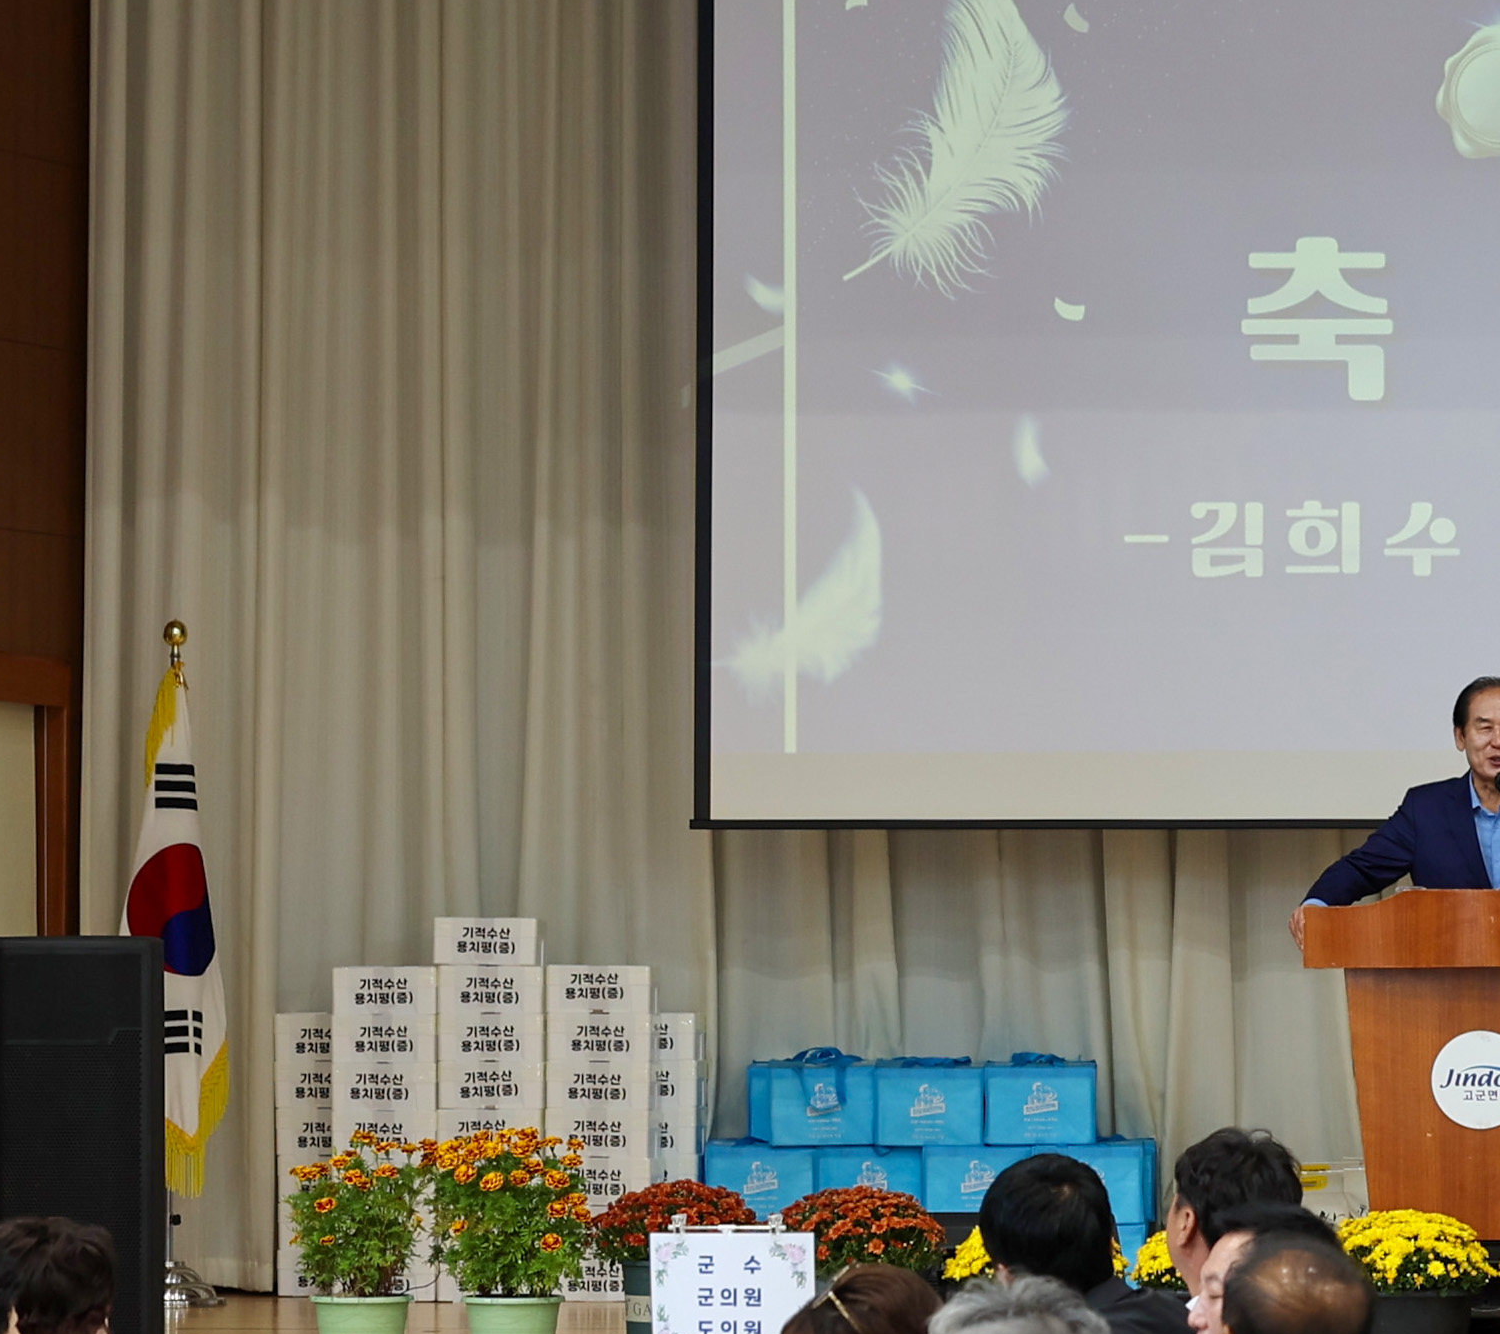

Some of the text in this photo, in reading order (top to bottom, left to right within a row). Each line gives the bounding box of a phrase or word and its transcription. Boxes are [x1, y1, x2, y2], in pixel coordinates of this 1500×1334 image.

[1240, 235, 1396, 403] 축
[1124, 499, 1464, 580] -김희수
[462, 927, 510, 939] 기적수산
[359, 978, 408, 990] 기적수산
[466, 977, 514, 989] 기적수산
[570, 973, 619, 985] 기적수산
[359, 1026, 408, 1038] 기적수산
[466, 1026, 514, 1038] 기적수산
[576, 1025, 625, 1038] 기적수산
[355, 1073, 404, 1086] 기적수산
[464, 1071, 512, 1083] 기적수산
[573, 1074, 621, 1086] 기적수산
[1463, 1090, 1498, 1101] 고군면
[573, 1121, 622, 1133] 기적수산
[584, 1265, 620, 1278] 적수산
[697, 1288, 762, 1307] 군의원
